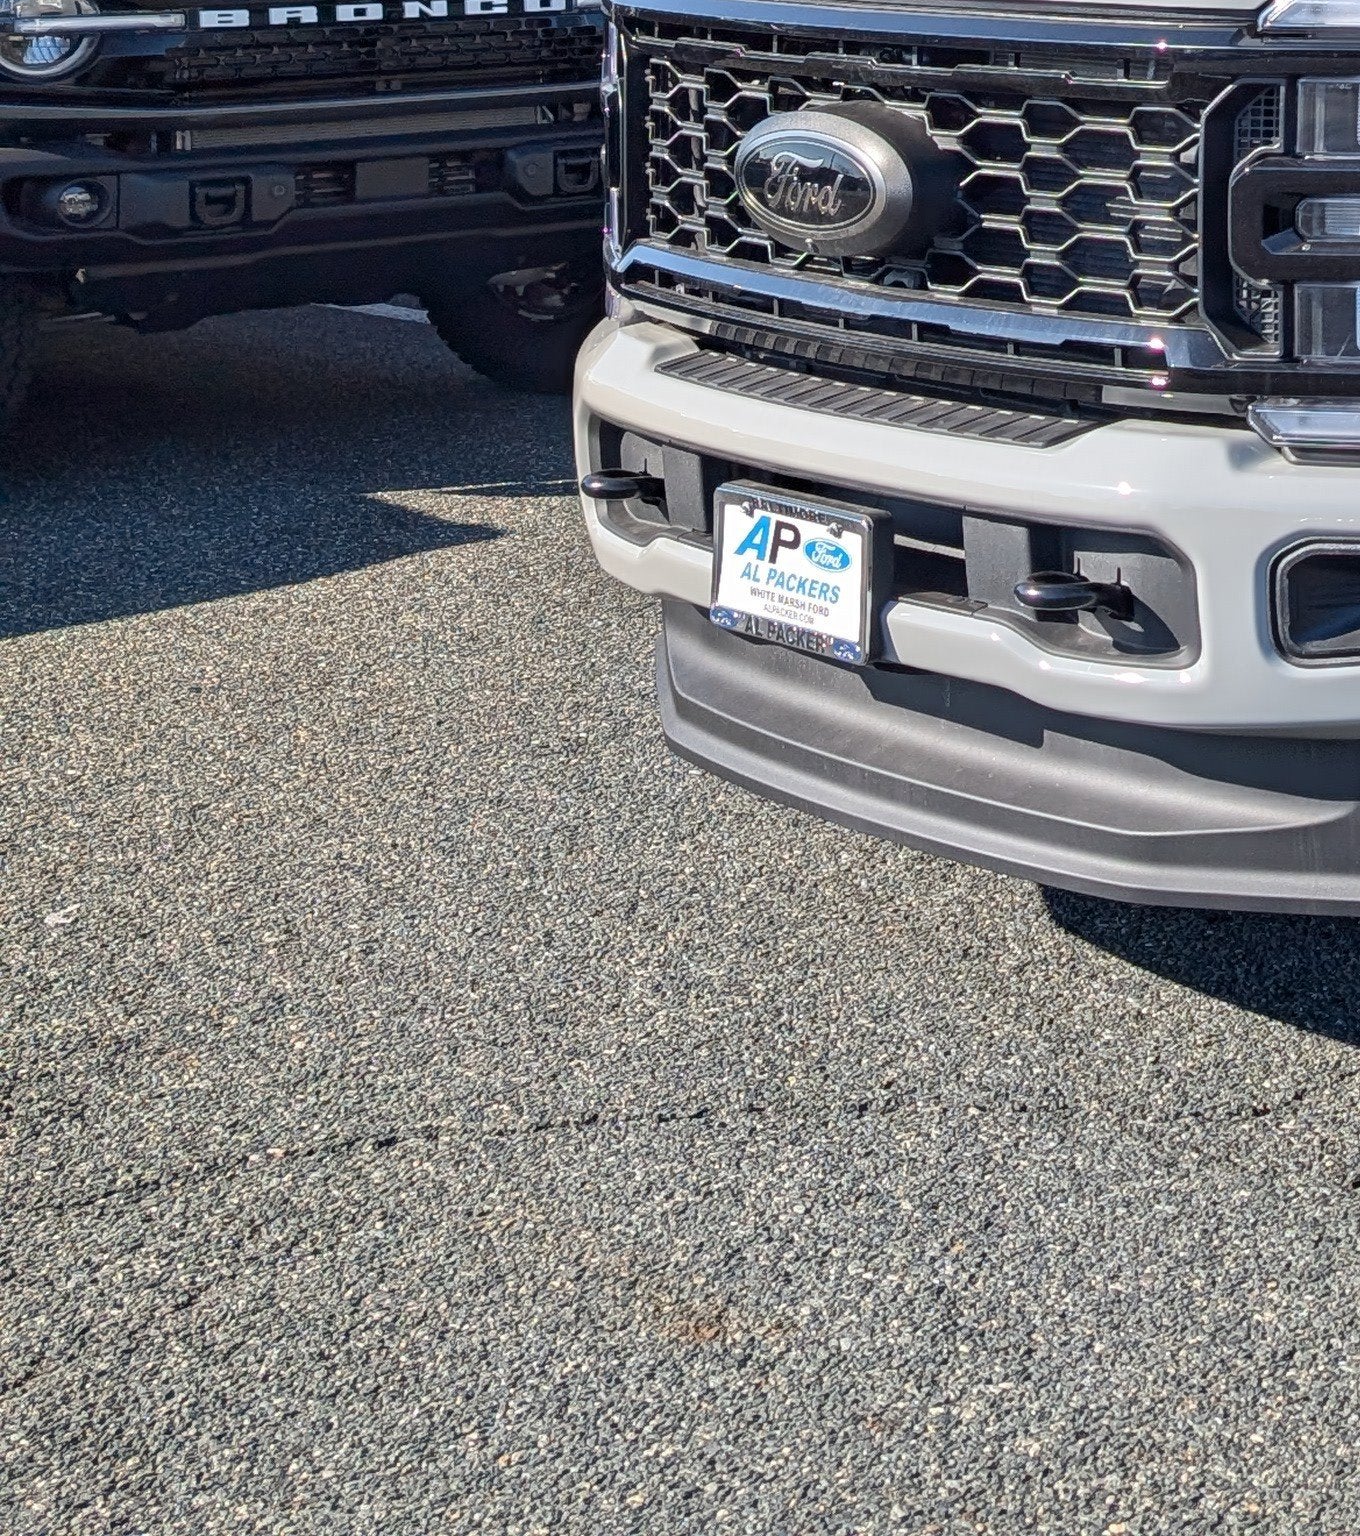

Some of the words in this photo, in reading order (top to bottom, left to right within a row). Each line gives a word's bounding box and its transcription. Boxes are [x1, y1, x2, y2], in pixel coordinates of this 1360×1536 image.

[763, 151, 844, 216] Ford
[733, 515, 802, 564] AP
[811, 540, 842, 569] Ford
[740, 561, 761, 583] AL
[765, 568, 841, 604] PACKERS
[750, 586, 776, 602] WHITE
[777, 594, 806, 610] MARSH
[807, 602, 830, 617] FORD
[745, 614, 762, 637] AL
[766, 620, 826, 654] PACKER
